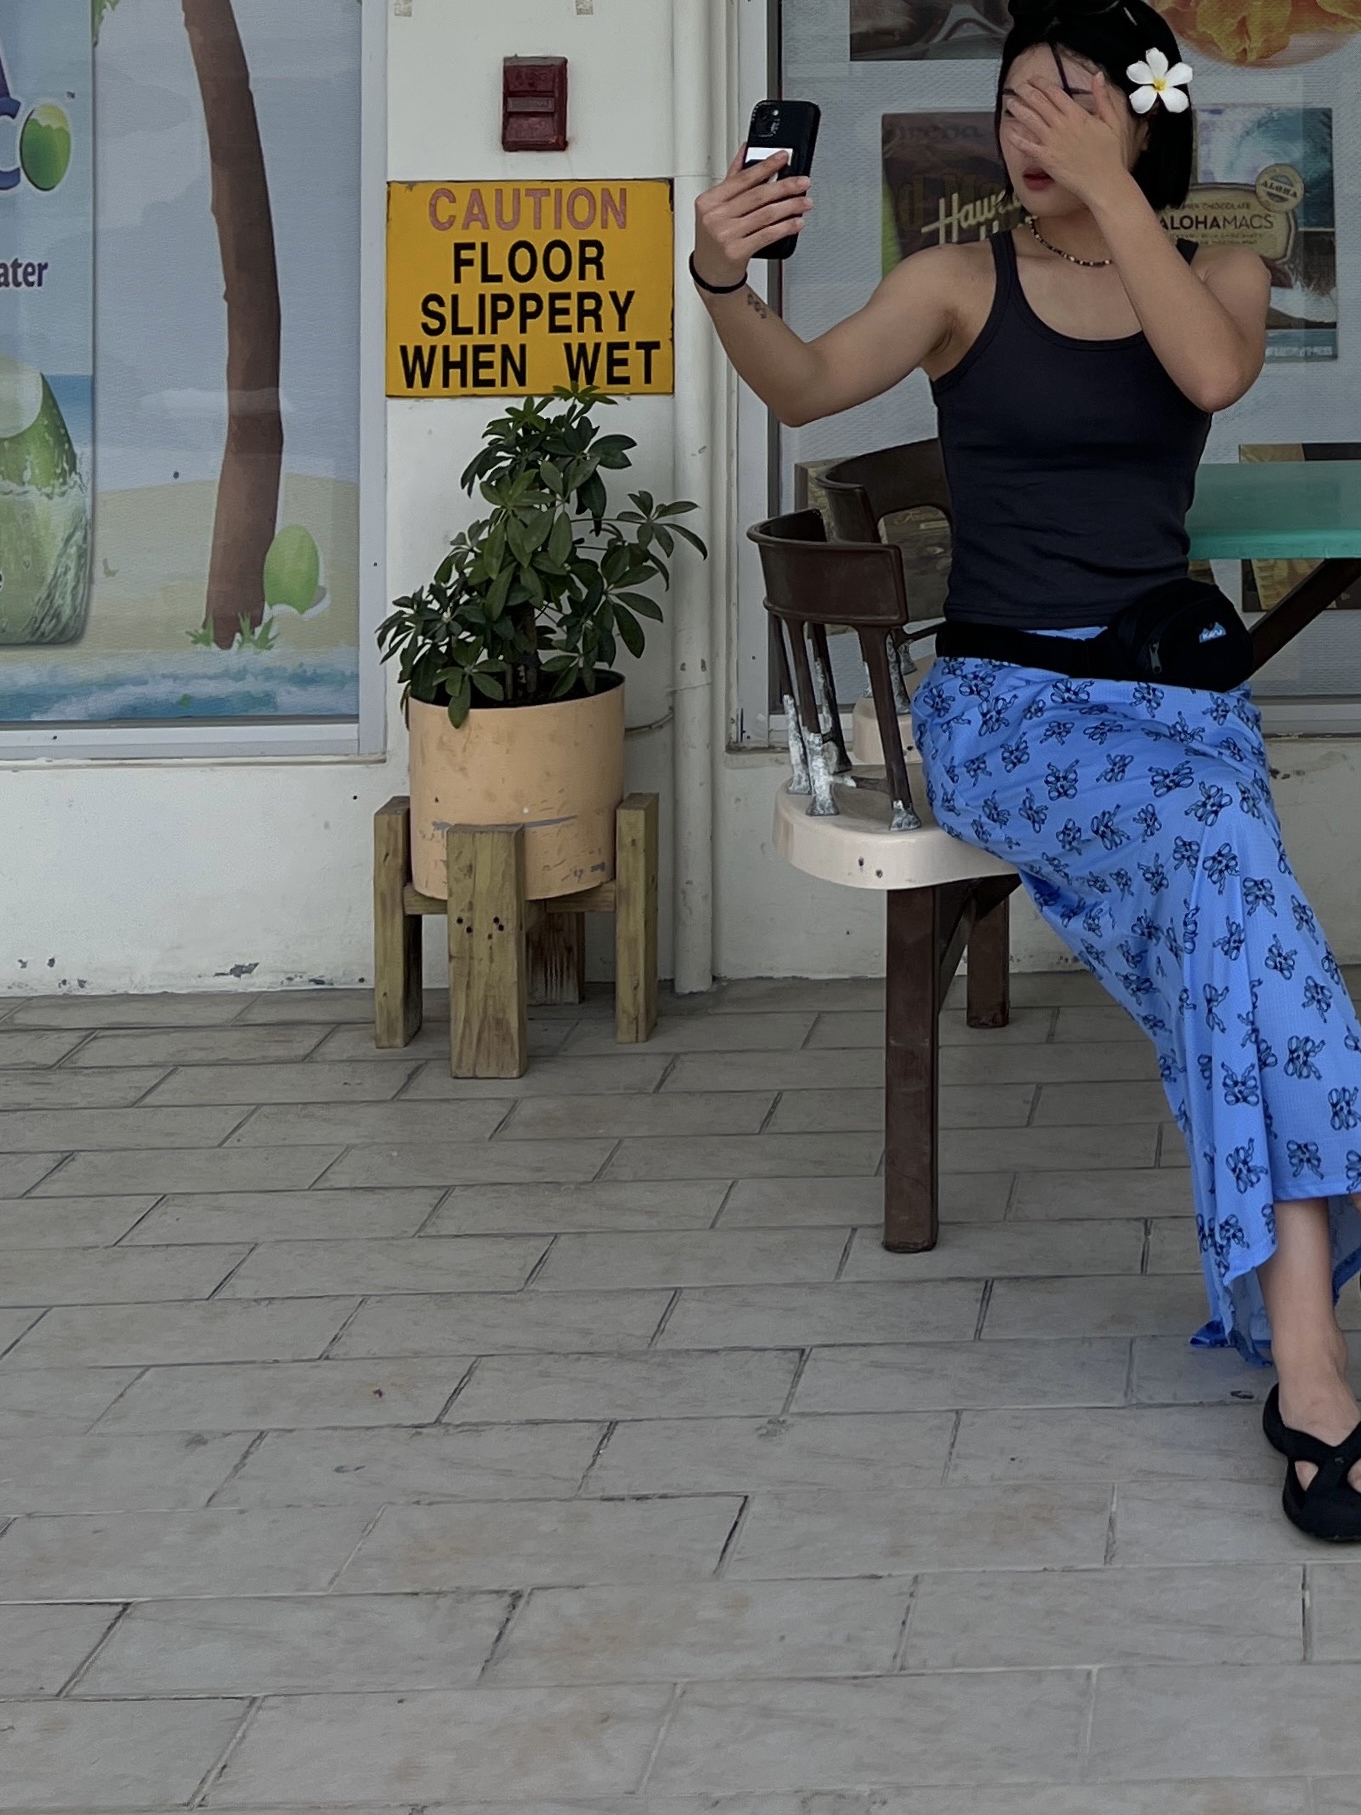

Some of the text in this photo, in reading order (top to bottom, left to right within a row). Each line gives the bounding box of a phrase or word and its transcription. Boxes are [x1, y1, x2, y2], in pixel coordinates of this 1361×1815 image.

[429, 187, 628, 231] CAUTION
[1159, 213, 1274, 230] ALOHAMACS
[453, 239, 606, 284] FLOOR
[421, 290, 636, 337] SLIPPERY
[400, 340, 661, 389] WHEN WET
